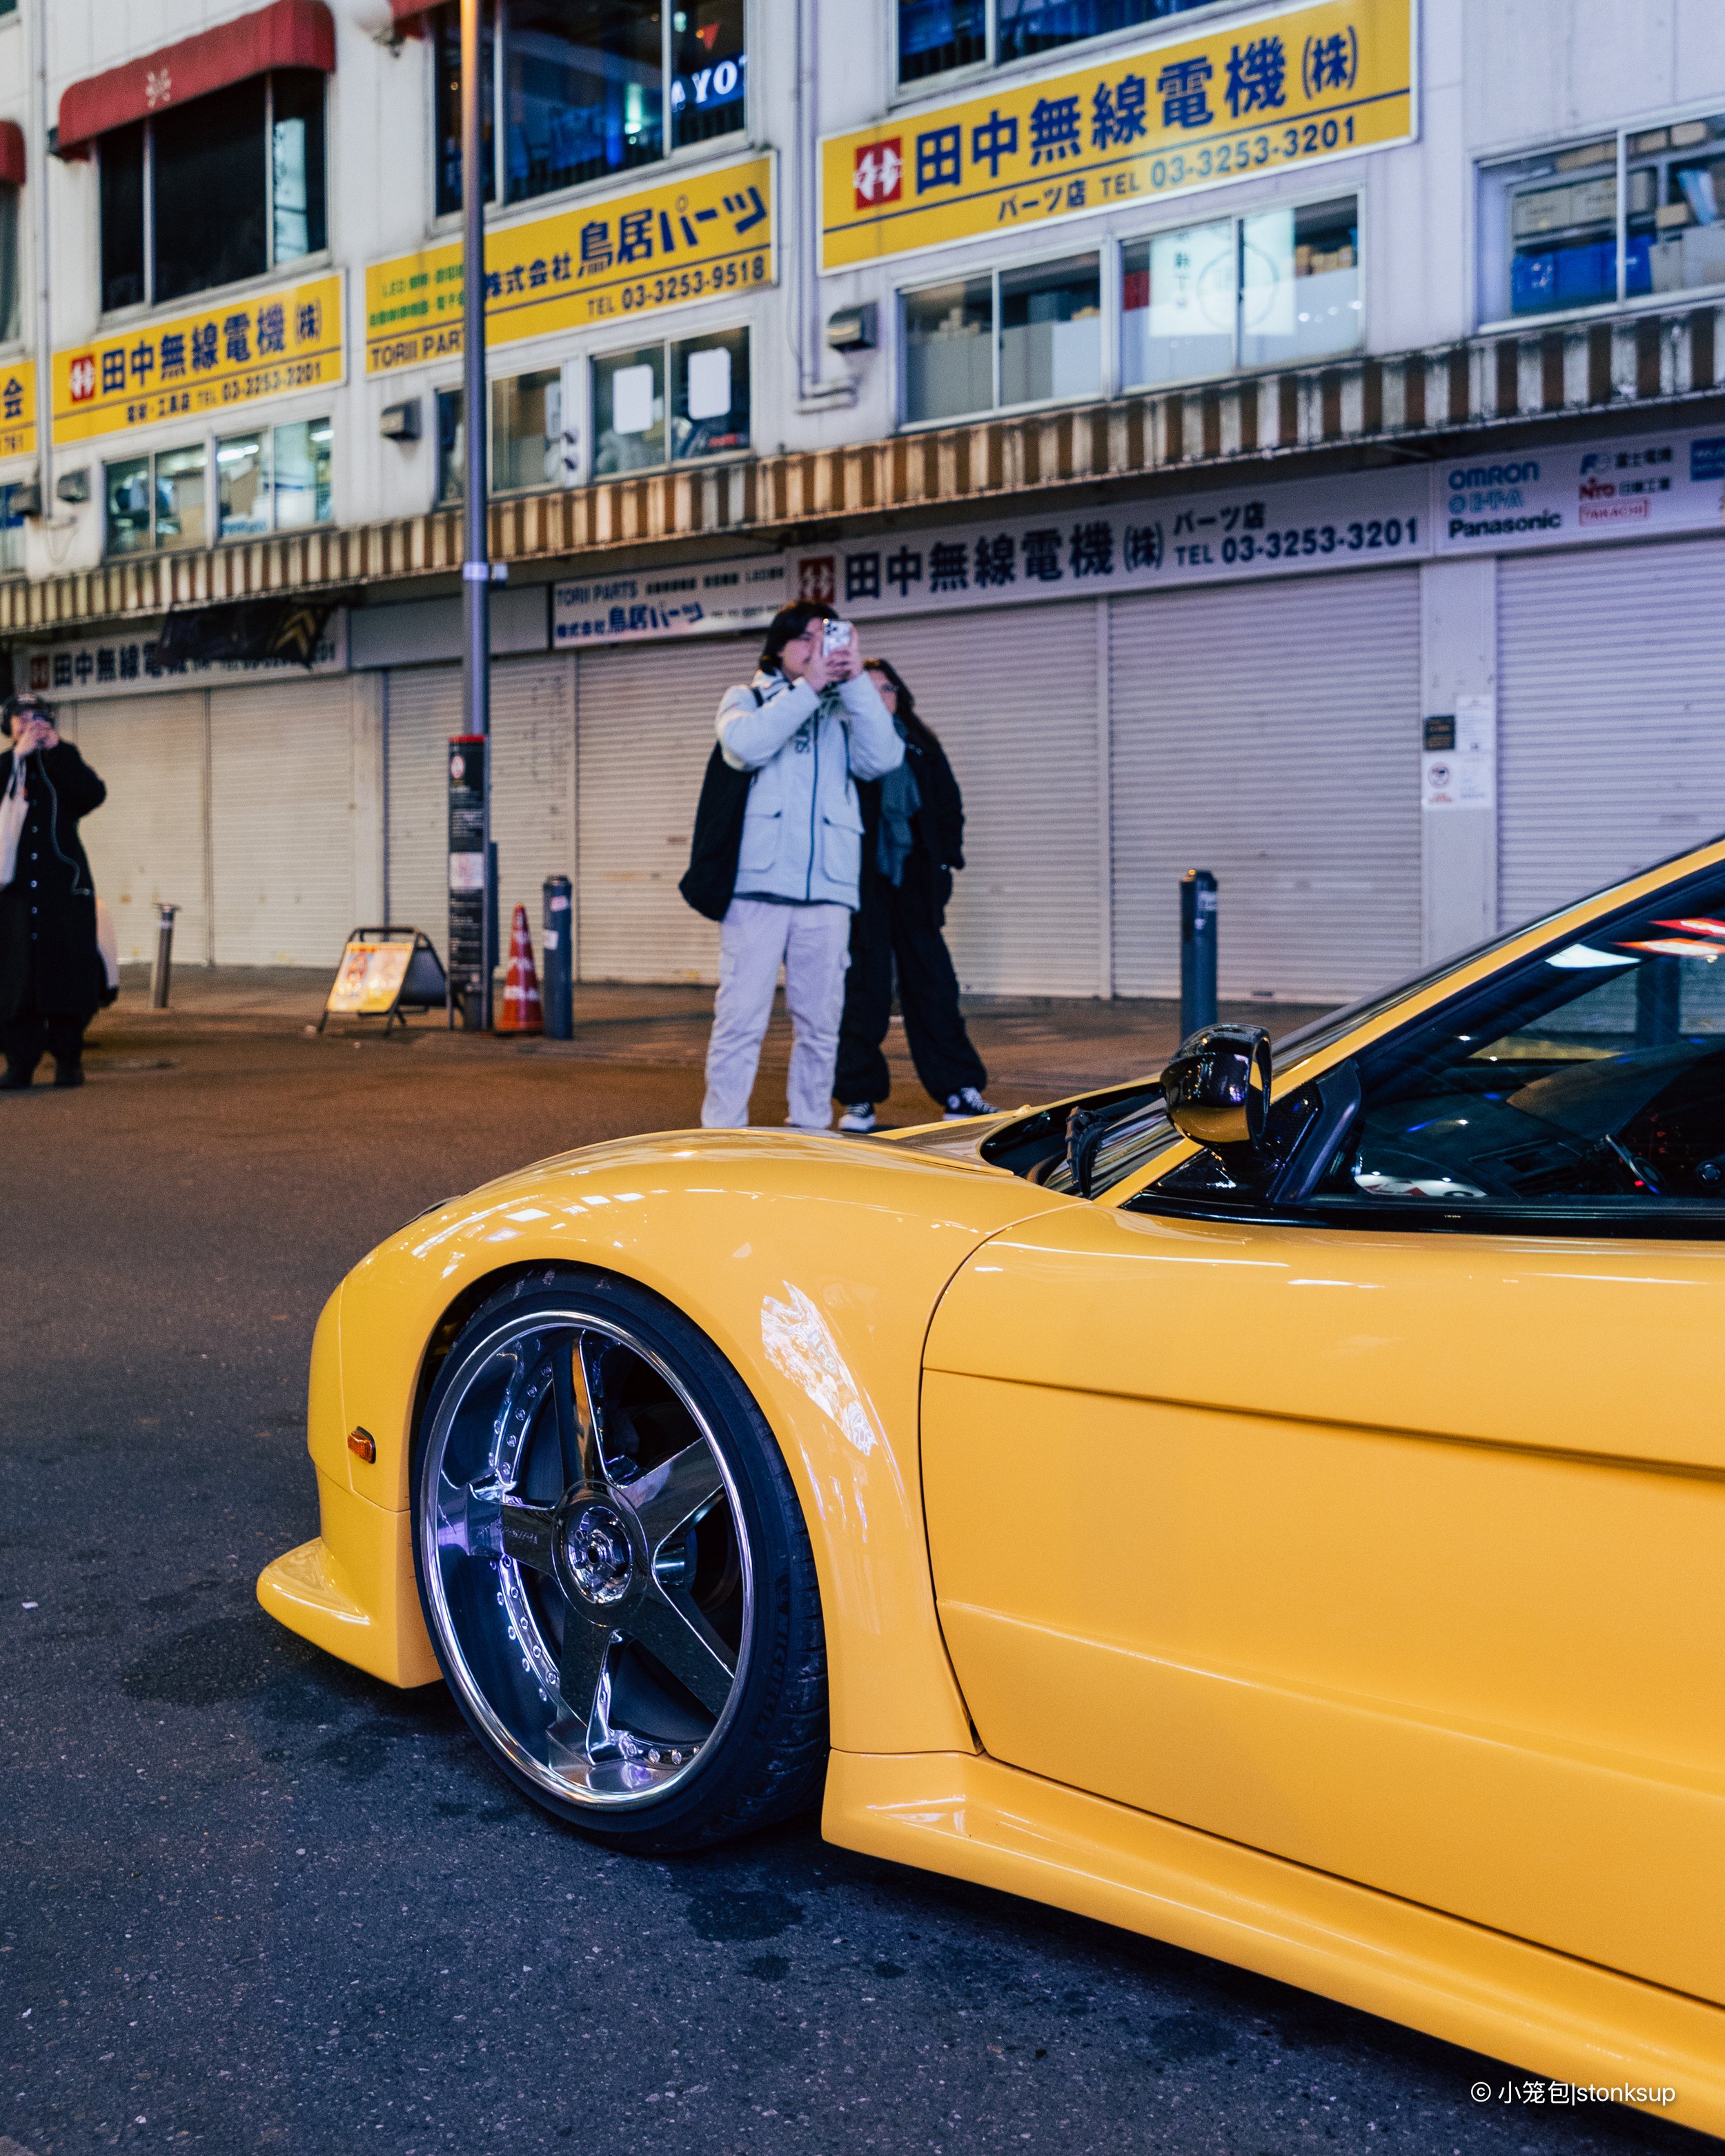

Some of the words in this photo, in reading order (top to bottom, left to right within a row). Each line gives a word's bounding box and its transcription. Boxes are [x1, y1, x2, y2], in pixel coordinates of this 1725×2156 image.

[1101, 172, 1140, 198] TEL
[1150, 116, 1354, 188] 03-3253-3201
[587, 299, 615, 317] TEL
[622, 256, 765, 309] 03-3253-9518
[1176, 545, 1214, 566] TEL
[1221, 517, 1417, 564] 03-3253-3201
[1449, 509, 1561, 539] Panasonic
